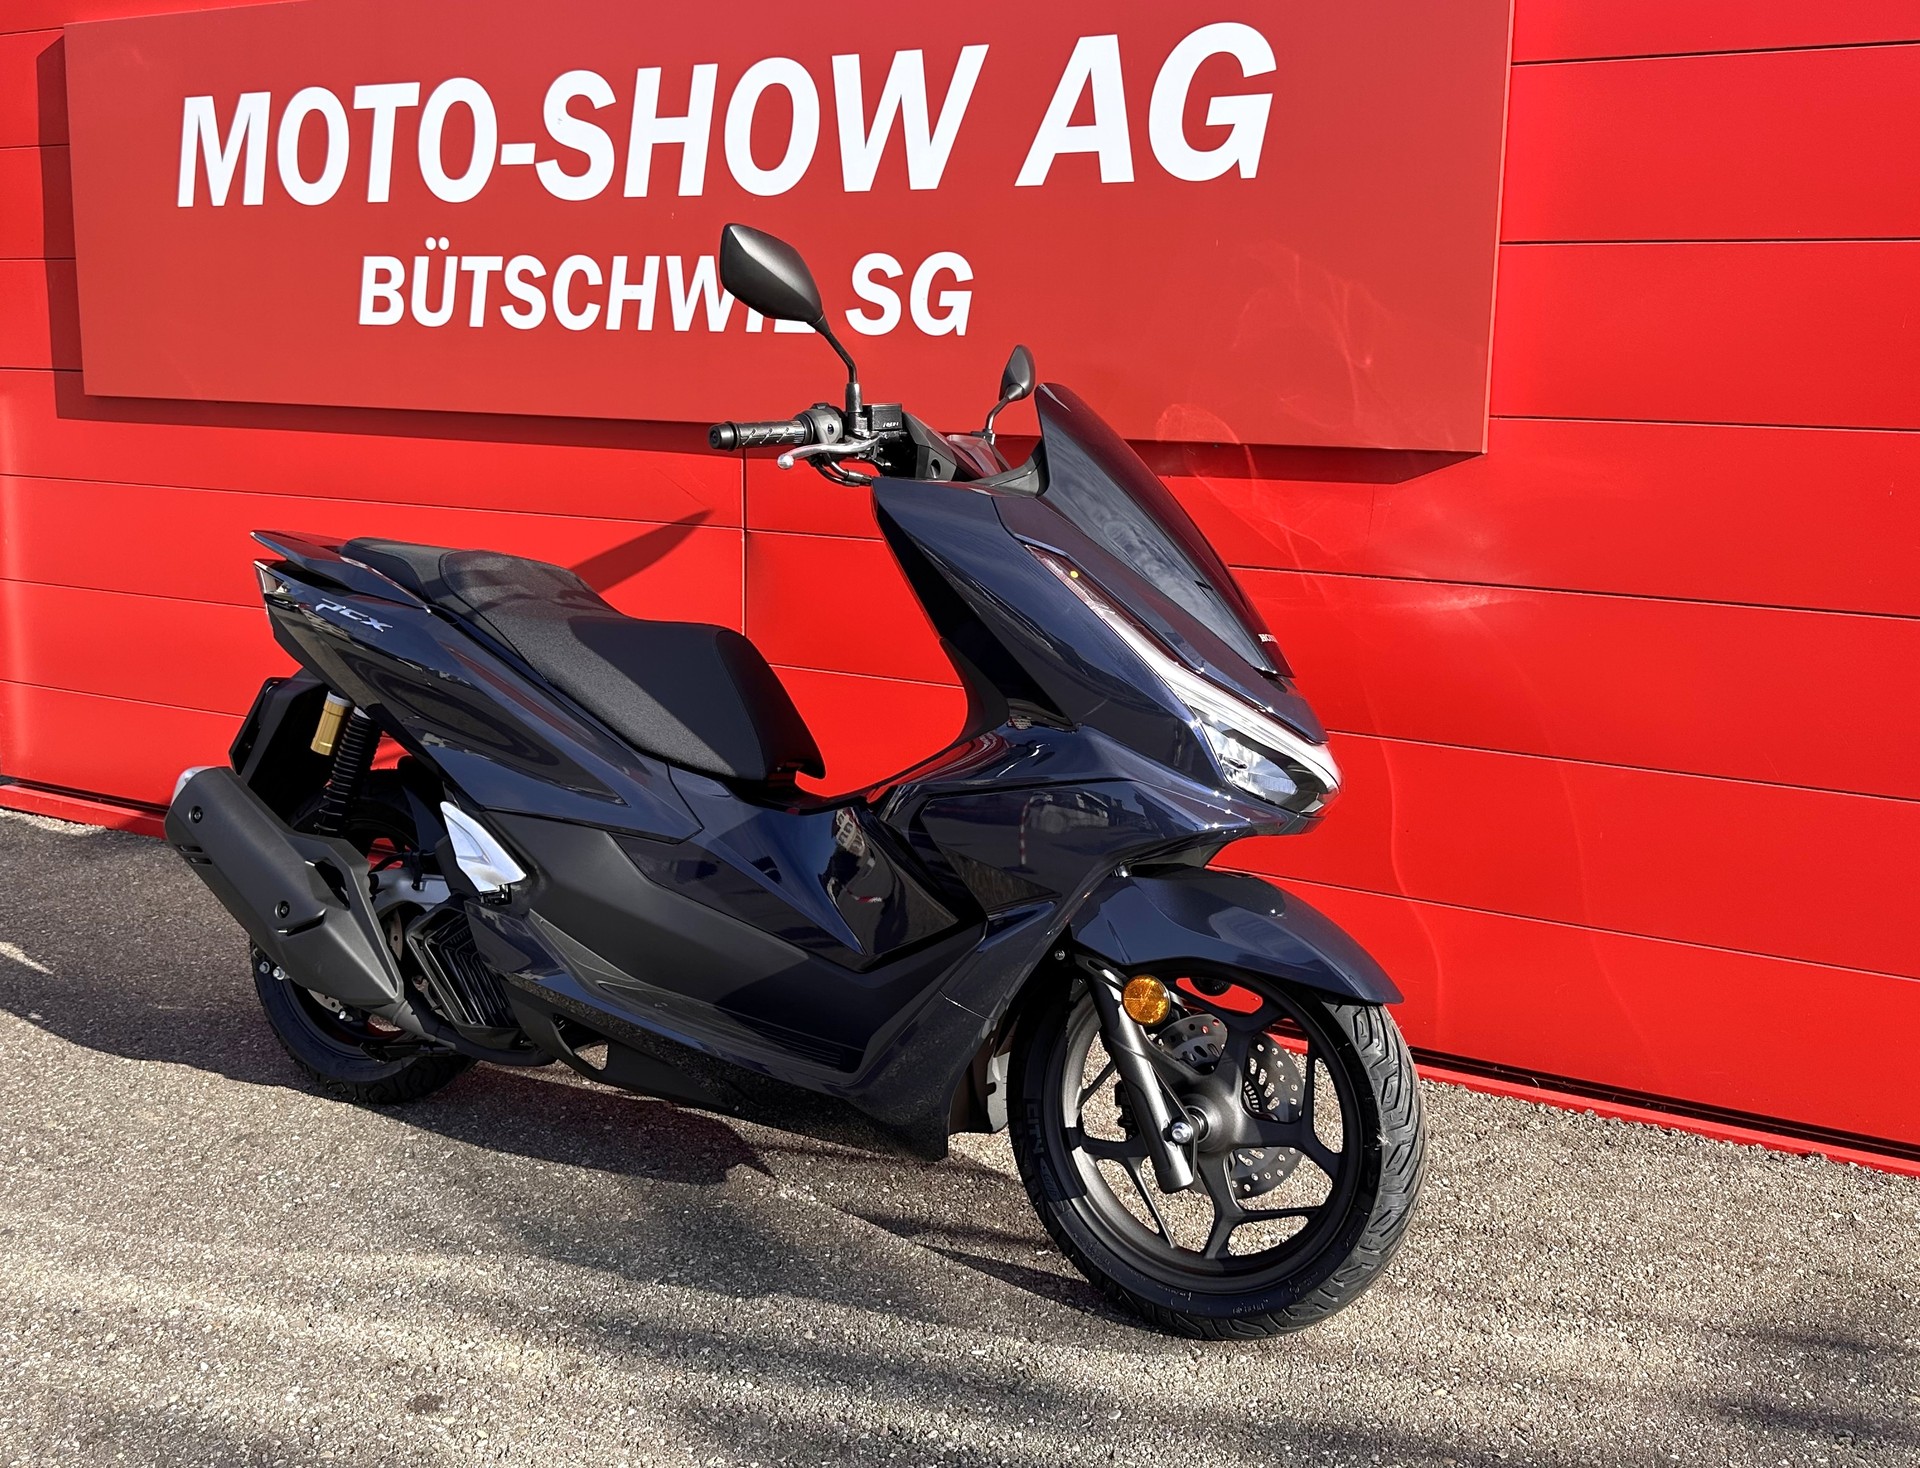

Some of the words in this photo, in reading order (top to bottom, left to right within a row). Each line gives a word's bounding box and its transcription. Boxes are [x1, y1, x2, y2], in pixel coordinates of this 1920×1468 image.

[177, 44, 990, 208] MOTO-SHOW
[1014, 22, 1277, 187] AG
[358, 236, 817, 334] BÜTSCHW
[845, 251, 974, 336] SG
[315, 598, 394, 633] PCX
